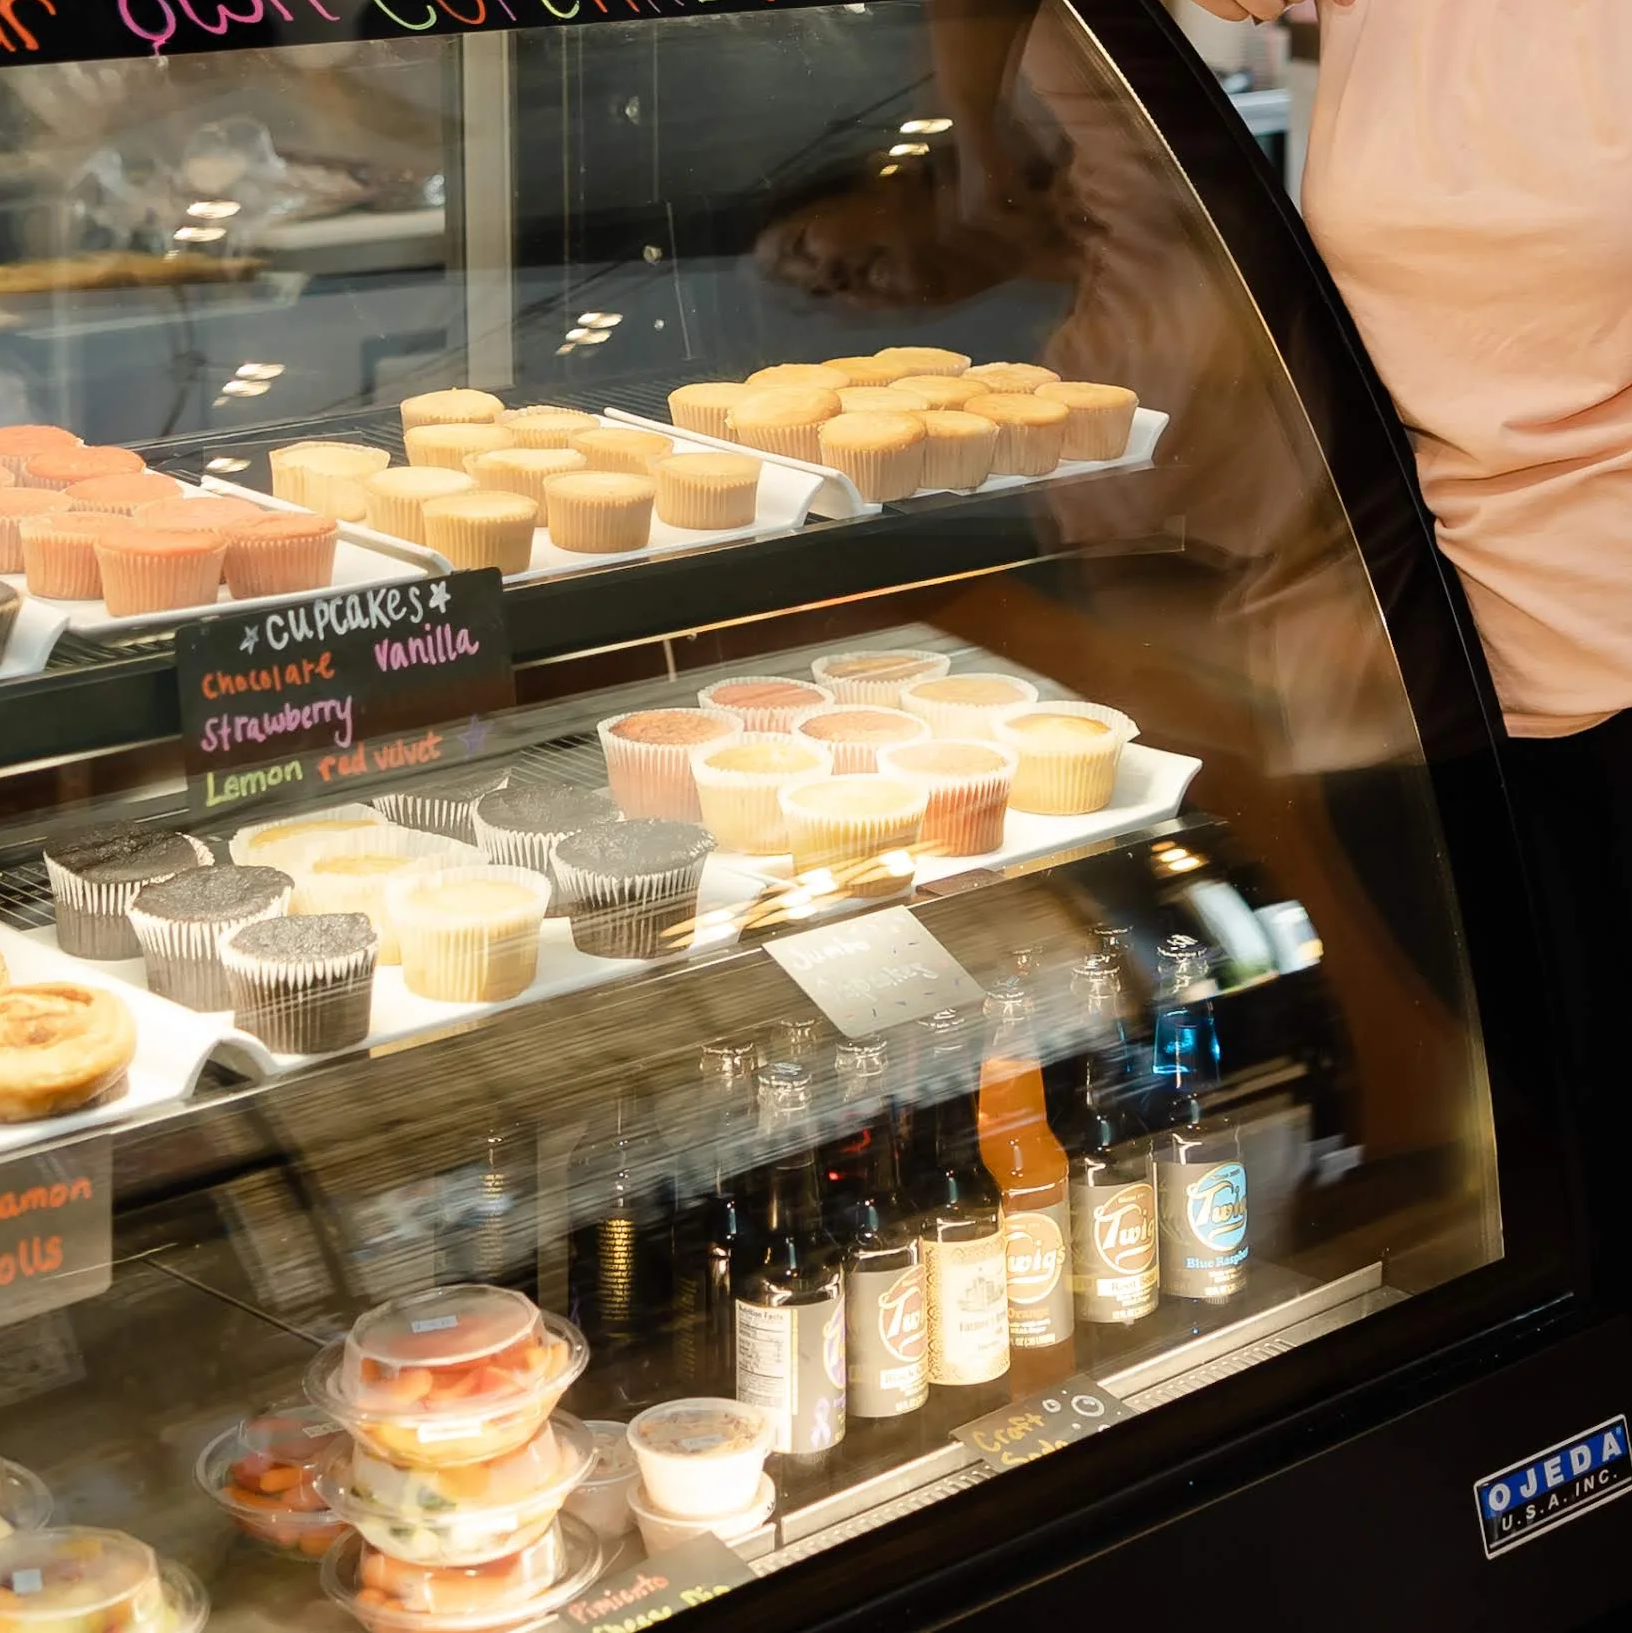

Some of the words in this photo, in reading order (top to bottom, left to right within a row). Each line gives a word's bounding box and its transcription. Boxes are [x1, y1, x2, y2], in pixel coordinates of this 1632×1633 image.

[374, 622, 479, 672] vanilla
[206, 760, 303, 808] Lemon
[318, 740, 367, 782] red
[373, 730, 443, 771] velvet
[1186, 1256, 1215, 1269] Blue
[972, 1413, 1046, 1453] Craft
[1488, 1431, 1623, 1512] OJEDA
[1502, 1493, 1568, 1532] U.S.A.
[1575, 1469, 1618, 1498] INC.
